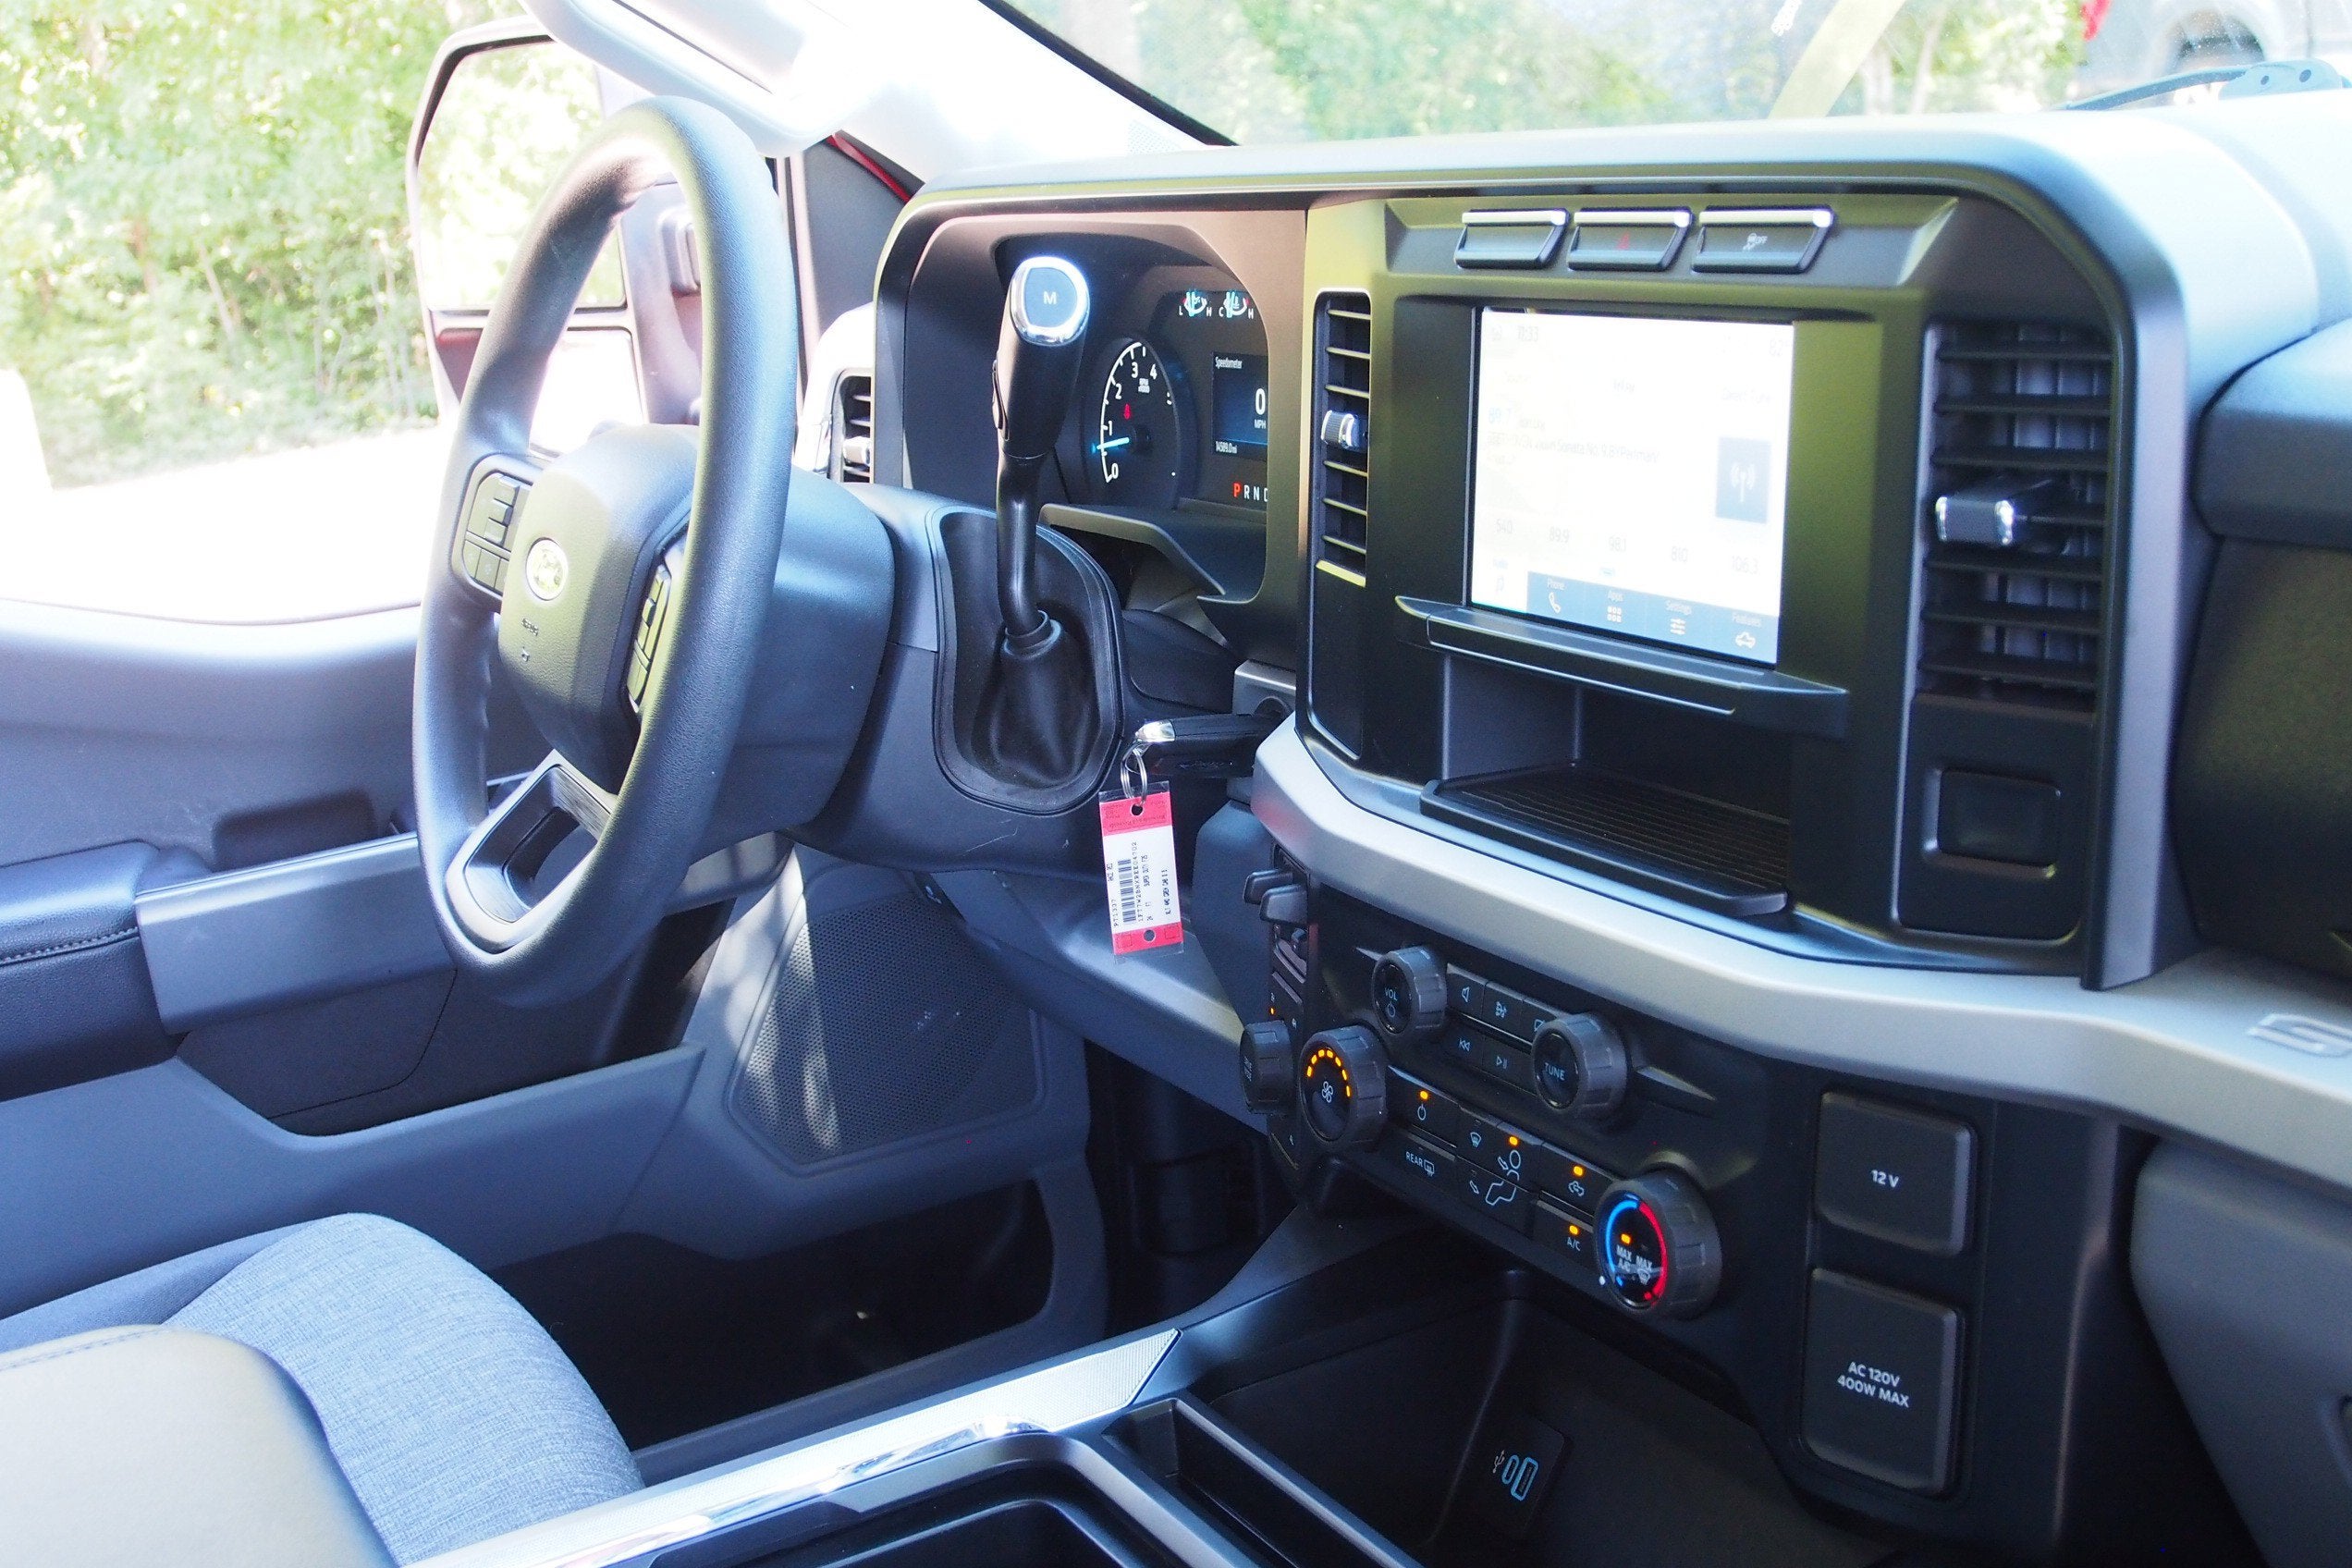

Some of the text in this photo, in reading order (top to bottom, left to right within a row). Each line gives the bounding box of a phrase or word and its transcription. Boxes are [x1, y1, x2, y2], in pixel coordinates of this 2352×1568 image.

[1043, 290, 1058, 305] M
[1207, 306, 1212, 317] H
[1219, 306, 1224, 317] C
[1248, 308, 1254, 320] H
[1131, 361, 1138, 379] 3
[1149, 363, 1158, 380] 4
[1115, 384, 1121, 399] 2
[1256, 387, 1266, 416] 0
[1108, 421, 1113, 435] 1
[1254, 419, 1267, 429] MPH
[1111, 462, 1119, 479] 0
[1233, 483, 1241, 498] P
[1243, 484, 1250, 499] R
[1253, 485, 1260, 501] N
[1547, 577, 1565, 591] Phone
[1385, 987, 1398, 1001] VOL
[1544, 1062, 1565, 1081] TUNE
[1405, 1151, 1424, 1168] REAR
[1871, 1170, 1900, 1187] 12 V
[1566, 1237, 1581, 1251] A/C
[1616, 1244, 1632, 1262] MAX
[1848, 1362, 1900, 1388] AC 120V
[1837, 1374, 1909, 1408] 400W MAX
